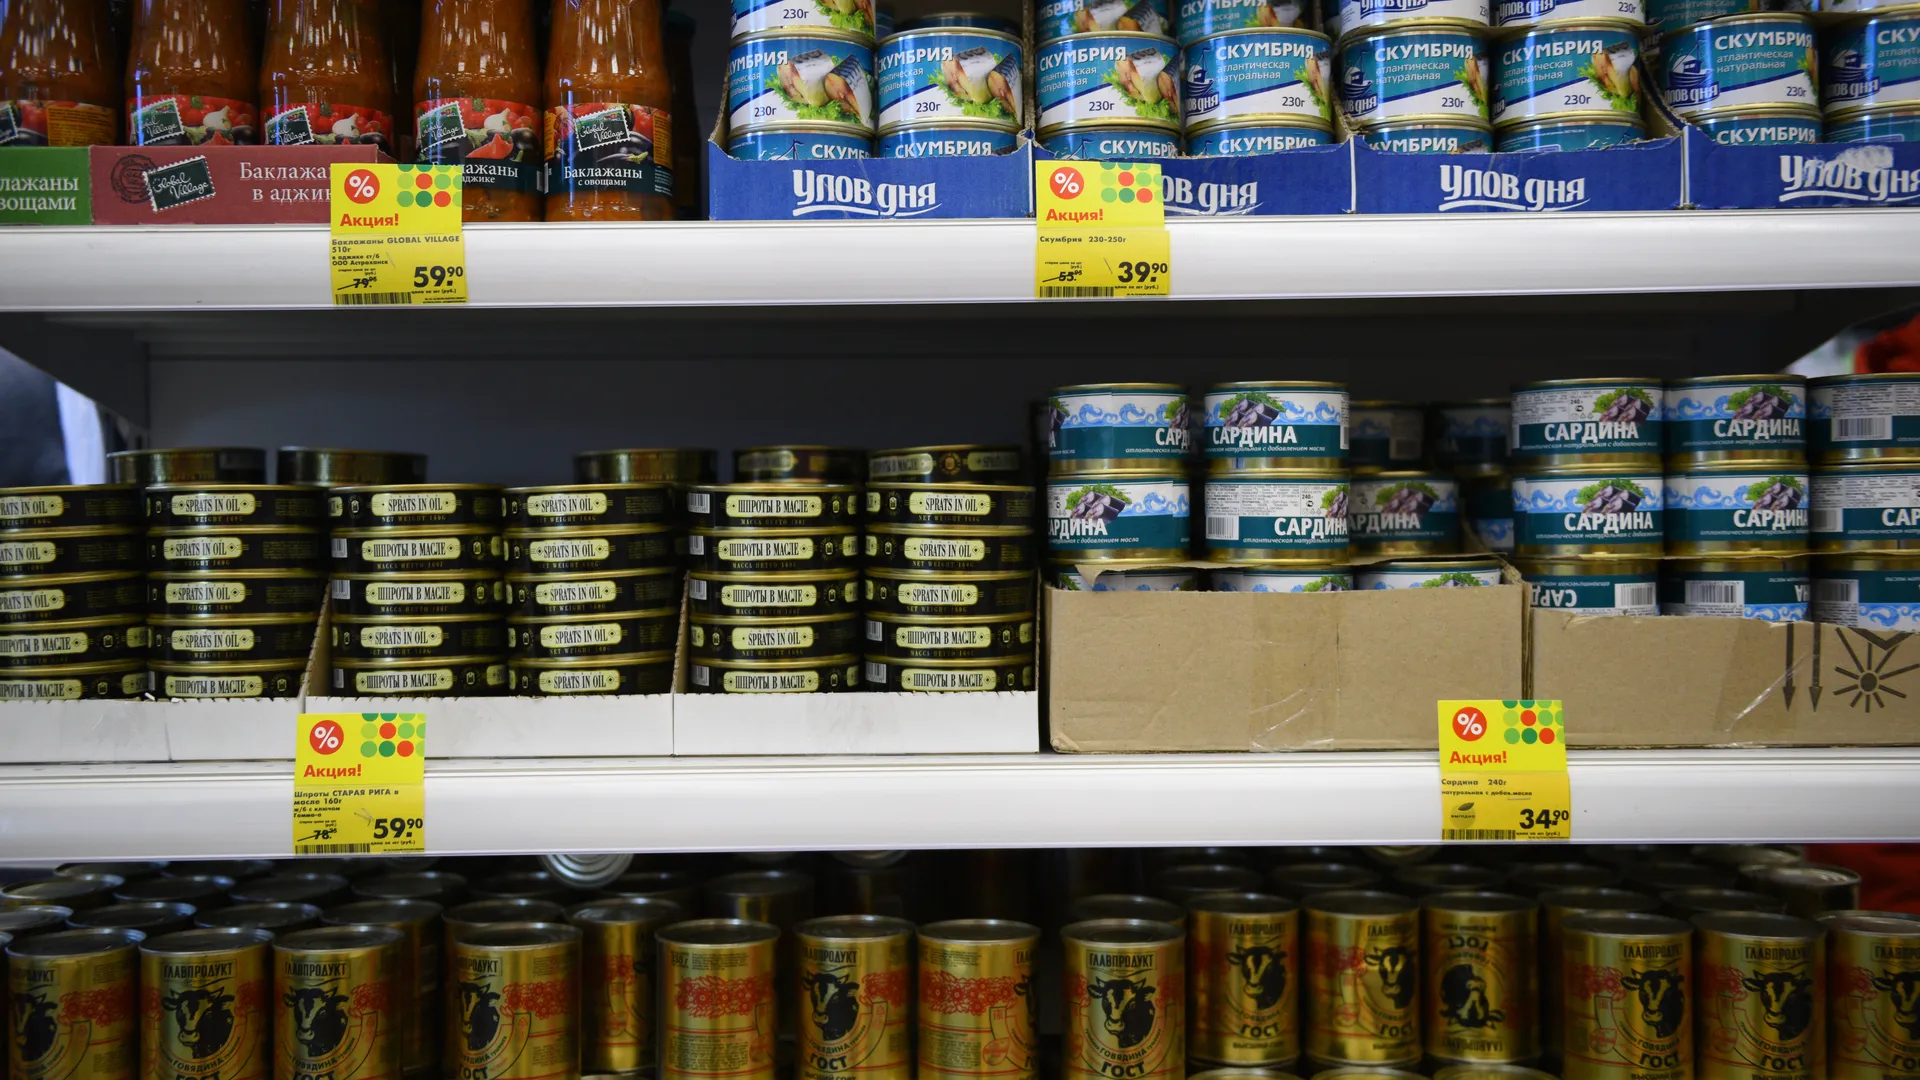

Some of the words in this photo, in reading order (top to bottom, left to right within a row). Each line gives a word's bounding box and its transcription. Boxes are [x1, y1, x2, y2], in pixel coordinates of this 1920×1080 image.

[783, 9, 809, 19] 230г
[1619, 2, 1636, 13] 230г
[1715, 31, 1813, 50] СКУМБРИЯ
[1040, 46, 1127, 71] СКУМБРИЯ
[1215, 42, 1314, 61] СКУМБРИЯ
[1374, 43, 1474, 62] СКУМБРИЯ
[1503, 39, 1603, 66] СКУМБРИЯ
[1716, 51, 1793, 63] атлантическая
[1217, 61, 1290, 73] атлантическая
[1375, 62, 1450, 75] атлантическая
[1504, 60, 1573, 78] атлантическая
[1716, 61, 1786, 73] натуральная
[1504, 71, 1563, 87] натуральная
[1786, 86, 1807, 98] 230г
[916, 102, 941, 113] 230г
[1089, 101, 1115, 112] 230г
[1282, 97, 1306, 107] 230г
[1441, 97, 1465, 108] 230г
[1564, 94, 1592, 106] 230г
[754, 106, 777, 117] 230г
[1716, 127, 1816, 145] СКУМБРИЯ
[895, 140, 992, 158] СКУМБРИЯ
[240, 161, 331, 180] Баклажа
[564, 165, 643, 180] Баклажаны
[584, 179, 627, 187] овощами
[253, 189, 264, 201] в
[340, 213, 399, 228] Акция!
[1046, 208, 1104, 223] Акция!
[1040, 236, 1082, 244] Скумбрия
[1213, 426, 1297, 447] САРДИНА
[1544, 421, 1639, 444] САРДИНА
[1713, 418, 1800, 440] САРДИНА
[186, 498, 212, 512] SPRATS
[214, 498, 224, 511] IN
[226, 498, 240, 511] OIL
[388, 497, 416, 512] SPRATS
[418, 498, 427, 511] IN
[429, 497, 443, 511] OIL
[541, 498, 567, 512] SPRATS
[569, 498, 578, 511] IN
[580, 497, 593, 511] OIL
[738, 499, 773, 513] ШПРОТЫ
[776, 499, 781, 512] В
[784, 499, 808, 512] МАСЛЕ
[926, 497, 953, 511] SPRATS
[954, 497, 963, 511] IN
[965, 498, 978, 512] OIL
[1048, 518, 1108, 540] АРДИНА
[1274, 517, 1348, 540] САРДИНА
[1564, 511, 1653, 534] САРДИНА
[373, 543, 409, 557] ШПРОТЫ
[411, 543, 417, 556] В
[419, 542, 446, 556] МАСЛЕ
[555, 630, 582, 644] SPRATS
[583, 630, 592, 643] IN
[594, 629, 608, 643] OIL
[907, 630, 941, 645] ШПРОТЫ
[943, 630, 949, 644] В
[951, 630, 977, 645] МАСЛЕ
[175, 680, 208, 693] ШПРОТЫ
[210, 680, 216, 692] В
[218, 679, 246, 693] МАСЛЕ
[1449, 751, 1507, 766] Акция!
[304, 764, 362, 779] Акция!
[1441, 779, 1479, 787] Сардина
[1089, 952, 1155, 968] ГЛАВПРОДУКТ
[1239, 1022, 1280, 1038] ГОСТ
[1100, 1046, 1147, 1062] ГОВЯДИНА
[1101, 1061, 1145, 1077] ГОСТ
